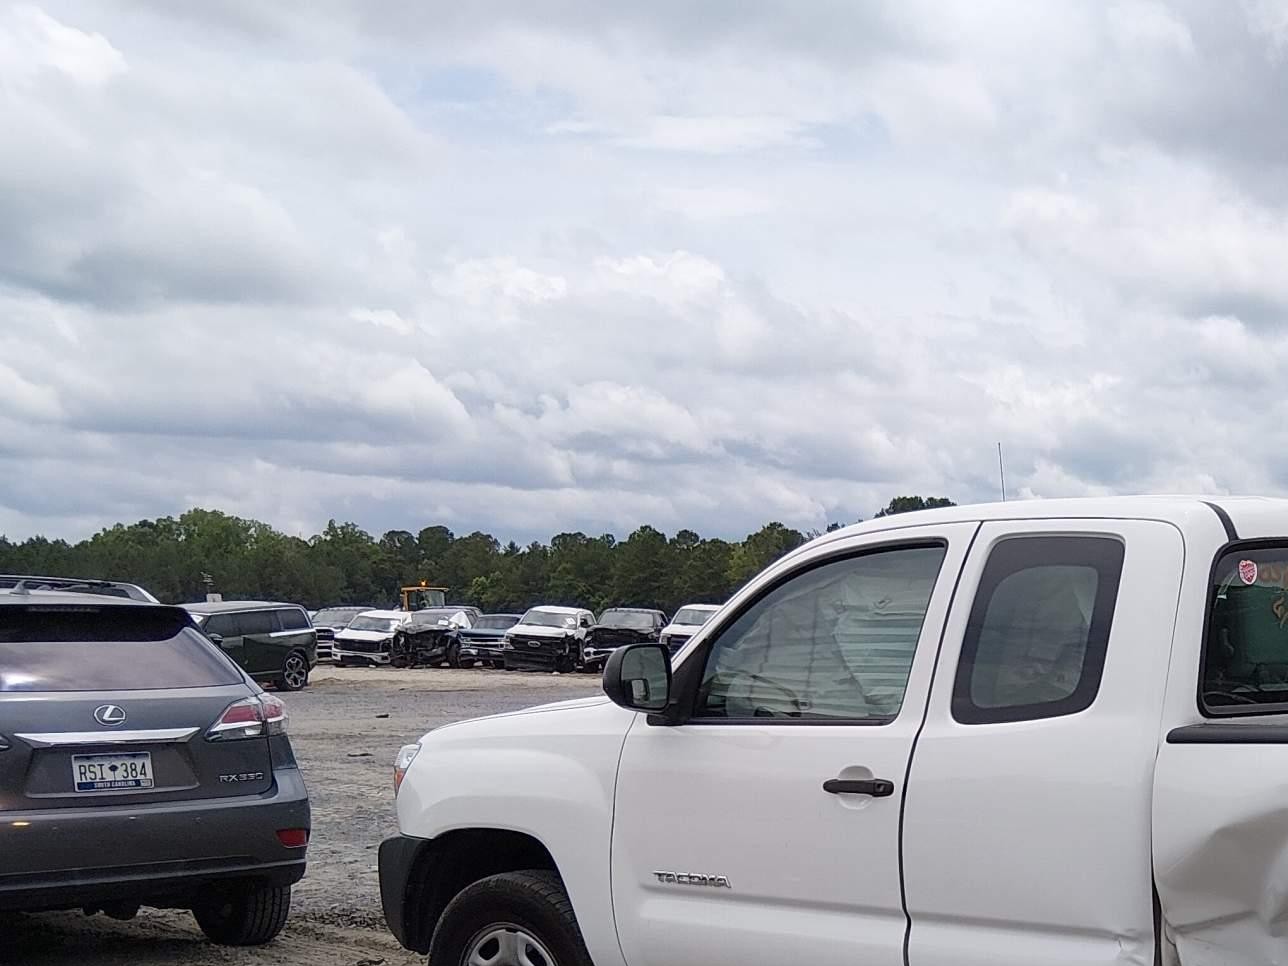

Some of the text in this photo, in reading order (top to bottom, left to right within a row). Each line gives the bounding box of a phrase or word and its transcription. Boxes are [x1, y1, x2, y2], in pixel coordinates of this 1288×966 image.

[79, 762, 147, 781] RSI 384
[653, 870, 731, 889] TACOMA
